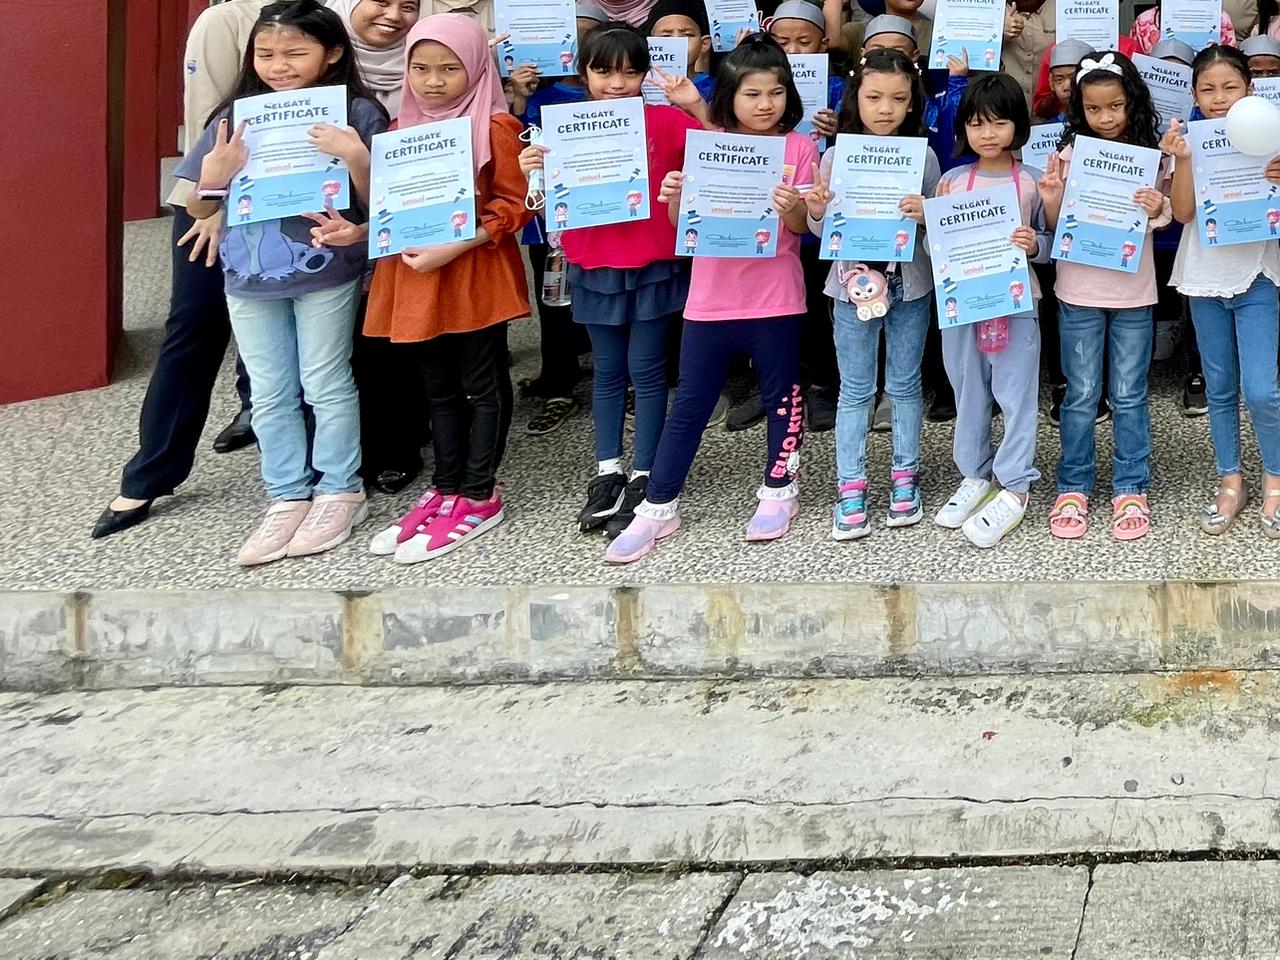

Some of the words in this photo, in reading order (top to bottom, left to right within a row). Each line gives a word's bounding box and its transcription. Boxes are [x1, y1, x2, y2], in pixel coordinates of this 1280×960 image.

[1140, 71, 1188, 88] CERTIFICATE
[248, 107, 329, 126] CERTIFICATE
[558, 118, 630, 133] CERTIFICATE
[385, 139, 456, 160] CERTIFICATE
[699, 152, 770, 166] CERTIFICATE
[847, 155, 912, 166] CERTIFICATE
[1084, 158, 1145, 176] CERTIFICATE
[940, 206, 1006, 227] CERTIFICATE
